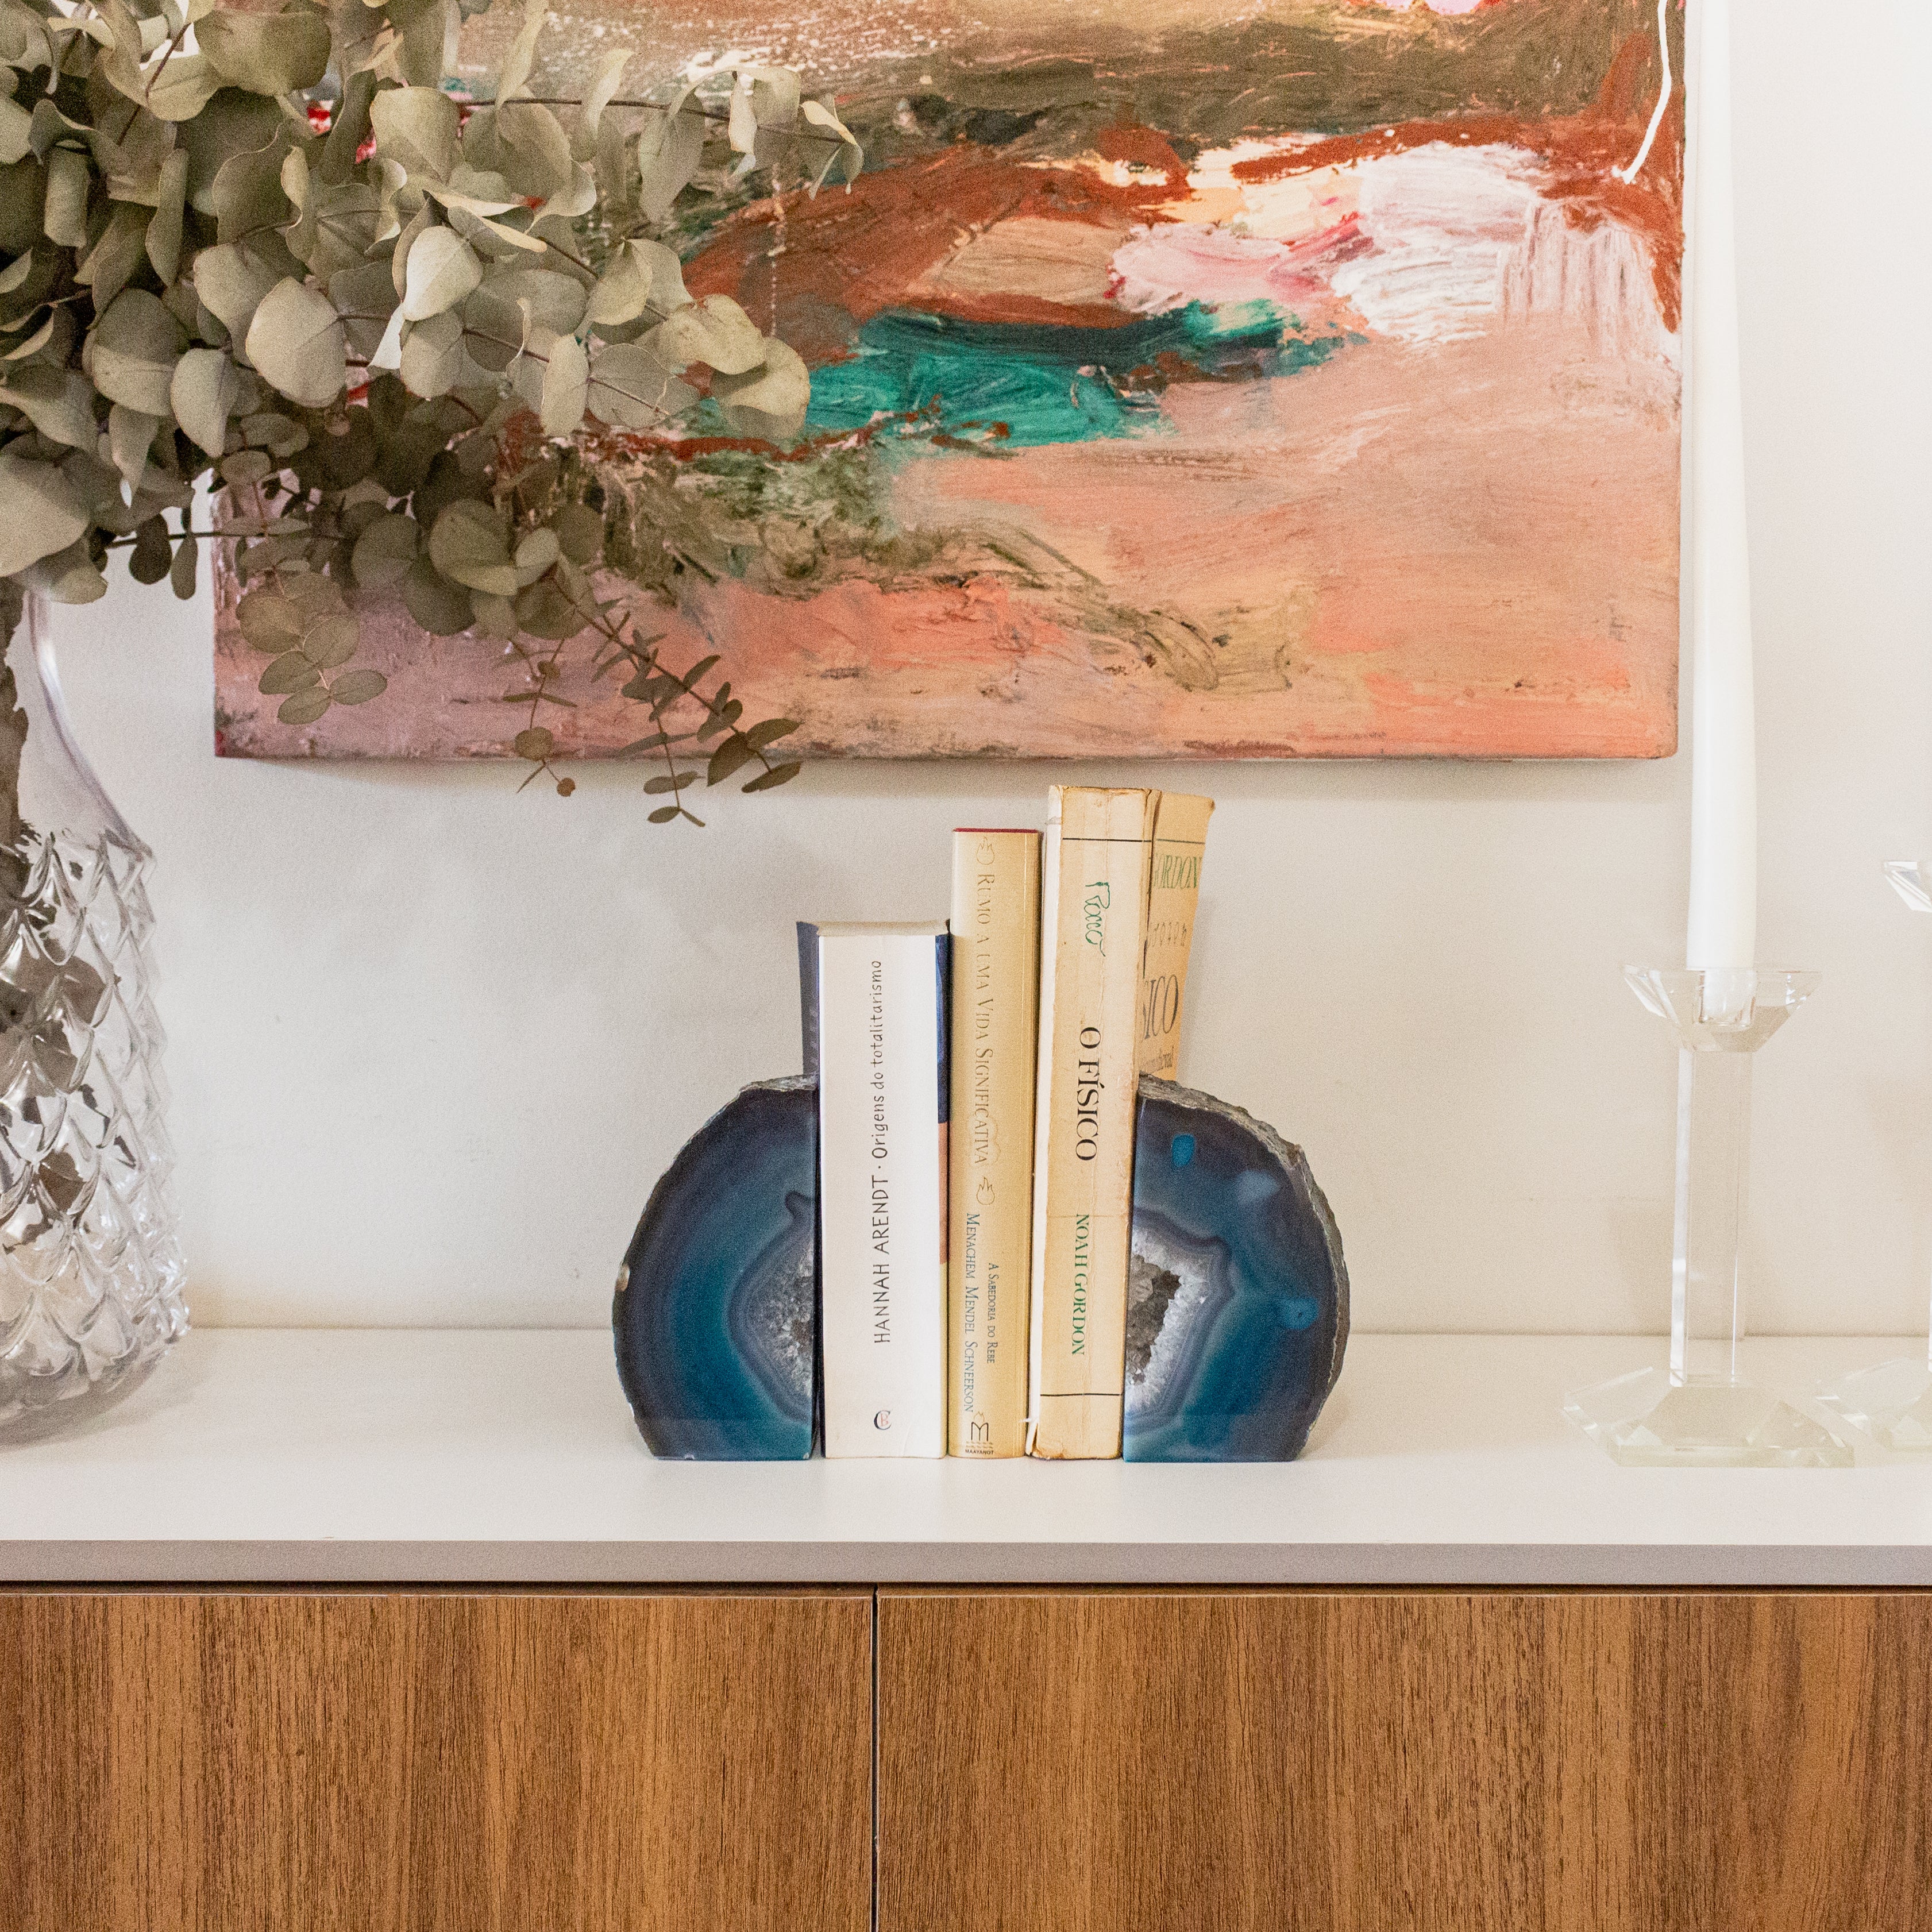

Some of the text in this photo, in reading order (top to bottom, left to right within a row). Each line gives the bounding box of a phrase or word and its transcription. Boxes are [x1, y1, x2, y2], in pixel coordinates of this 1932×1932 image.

[974, 874, 996, 1164] RUMO A UMA VIDA SIGNIFICATIVA
[869, 960, 890, 1343] HANNAH ARENDT Origens do totalitarismo
[1075, 1027, 1105, 1161] O FÍSICO
[963, 1212, 980, 1413] MENACHEM MENDEL SCHNEERSON
[987, 1274, 1000, 1321] SABEDORIA
[989, 1262, 1000, 1271] A
[1071, 1213, 1090, 1356] NOAH GORDON
[986, 1341, 998, 1364] REBE
